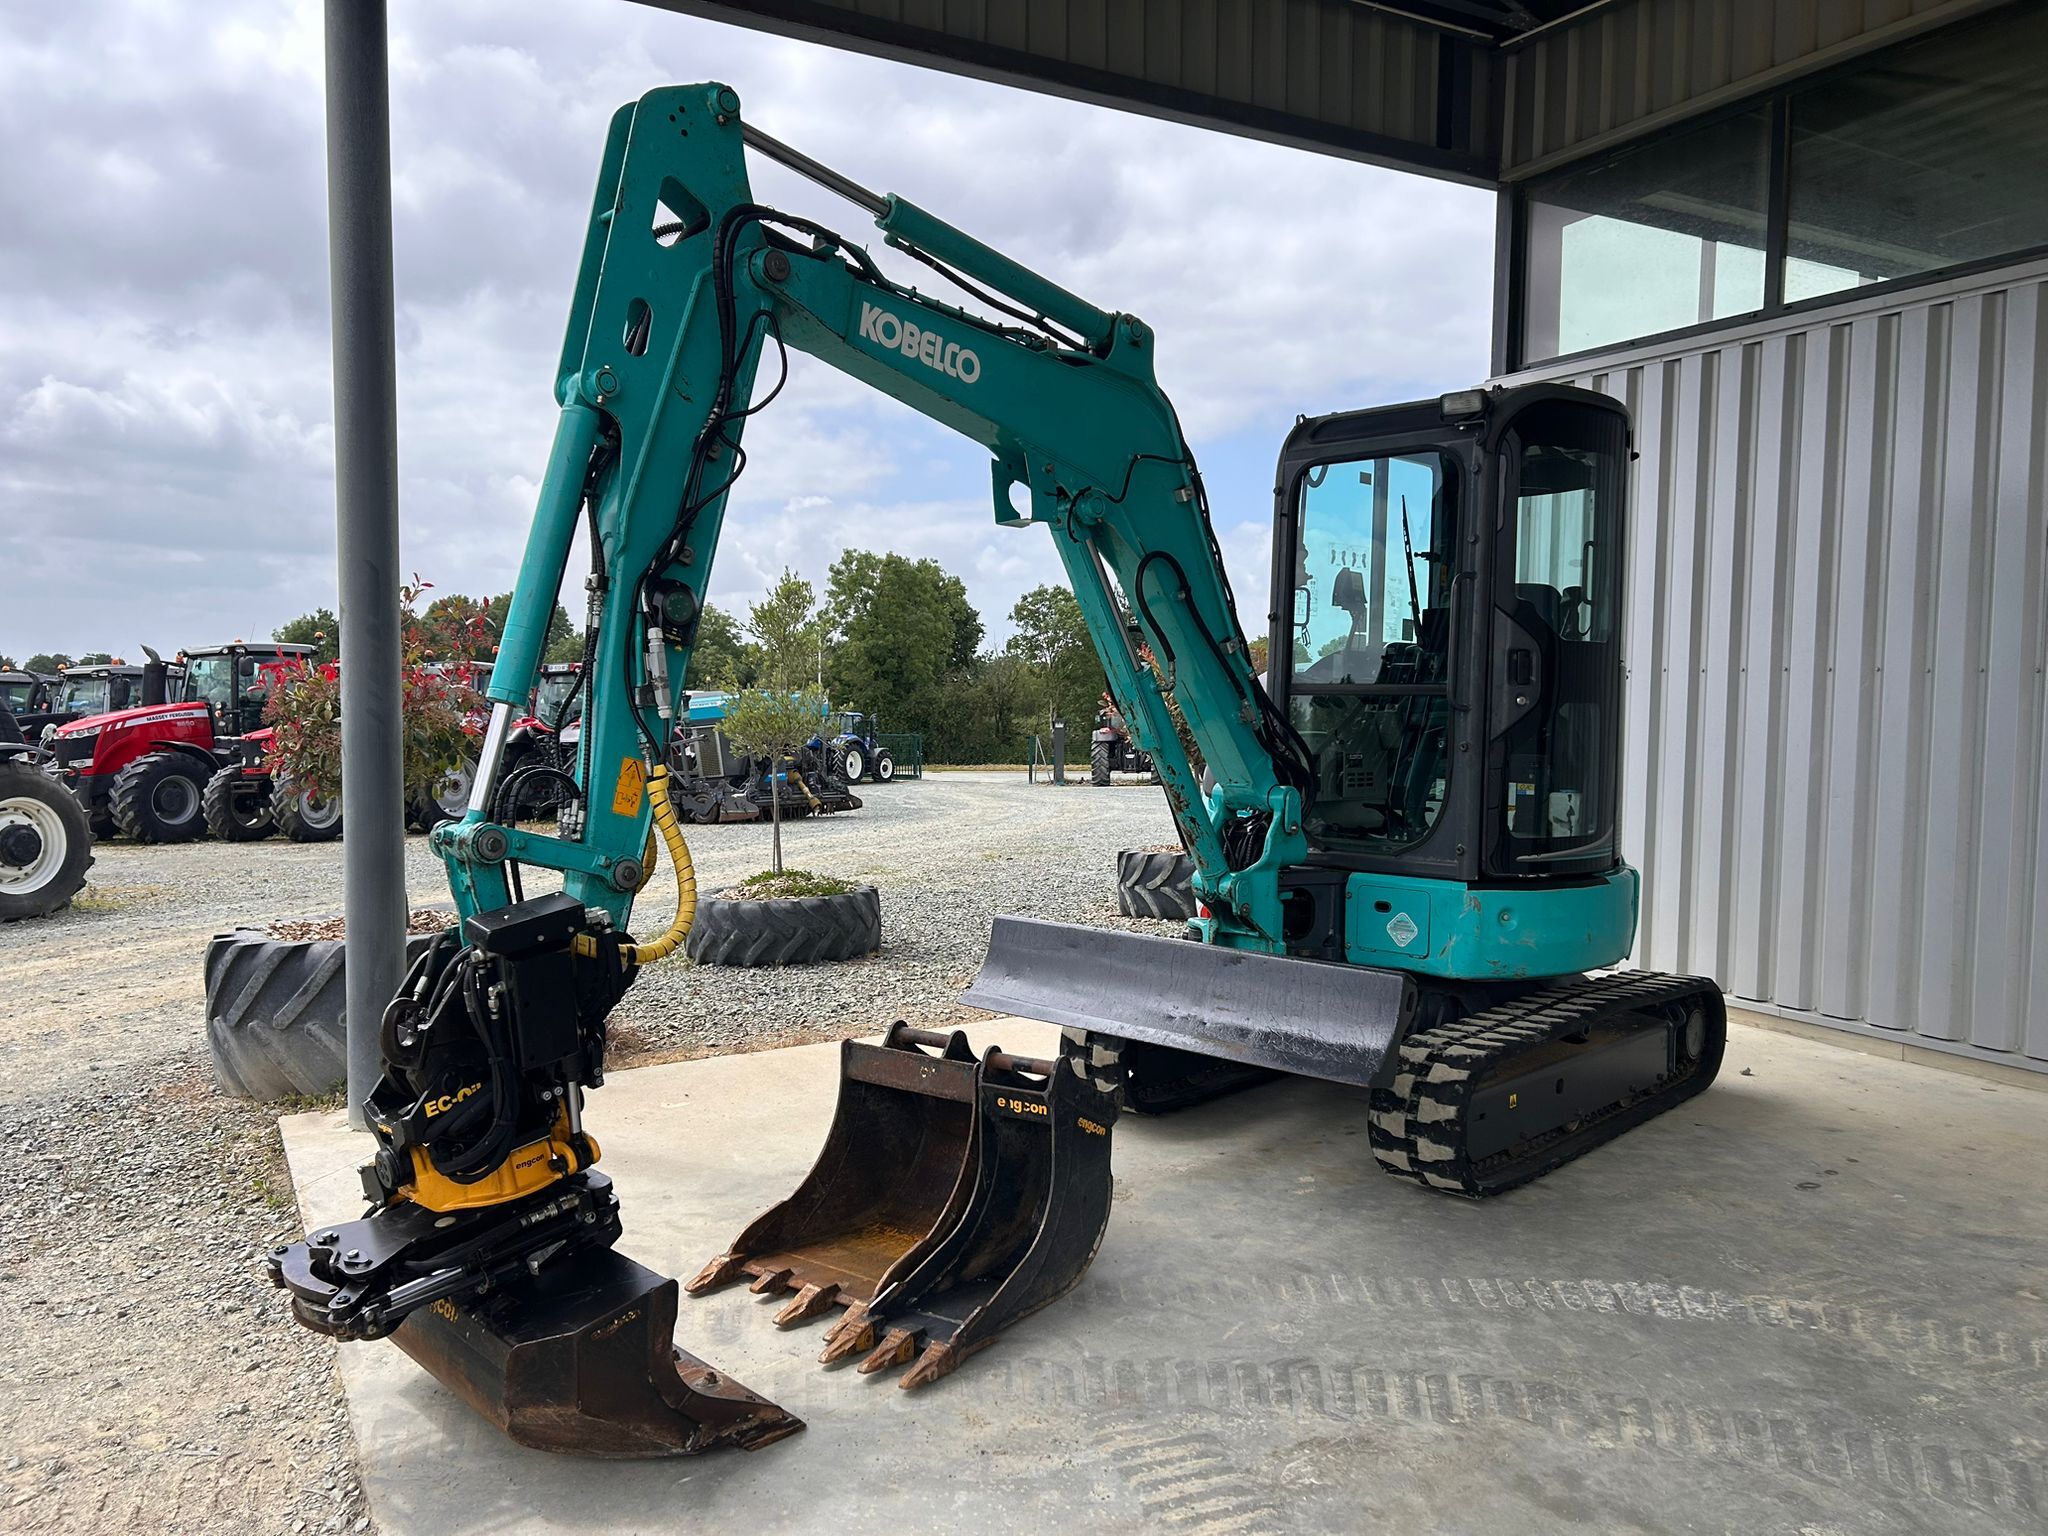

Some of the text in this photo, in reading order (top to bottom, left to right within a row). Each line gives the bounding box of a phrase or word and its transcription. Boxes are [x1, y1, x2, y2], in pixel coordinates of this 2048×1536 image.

[859, 301, 981, 384] KOBELCO
[1077, 1117, 1106, 1135] engcon
[515, 1153, 545, 1169] engcon
